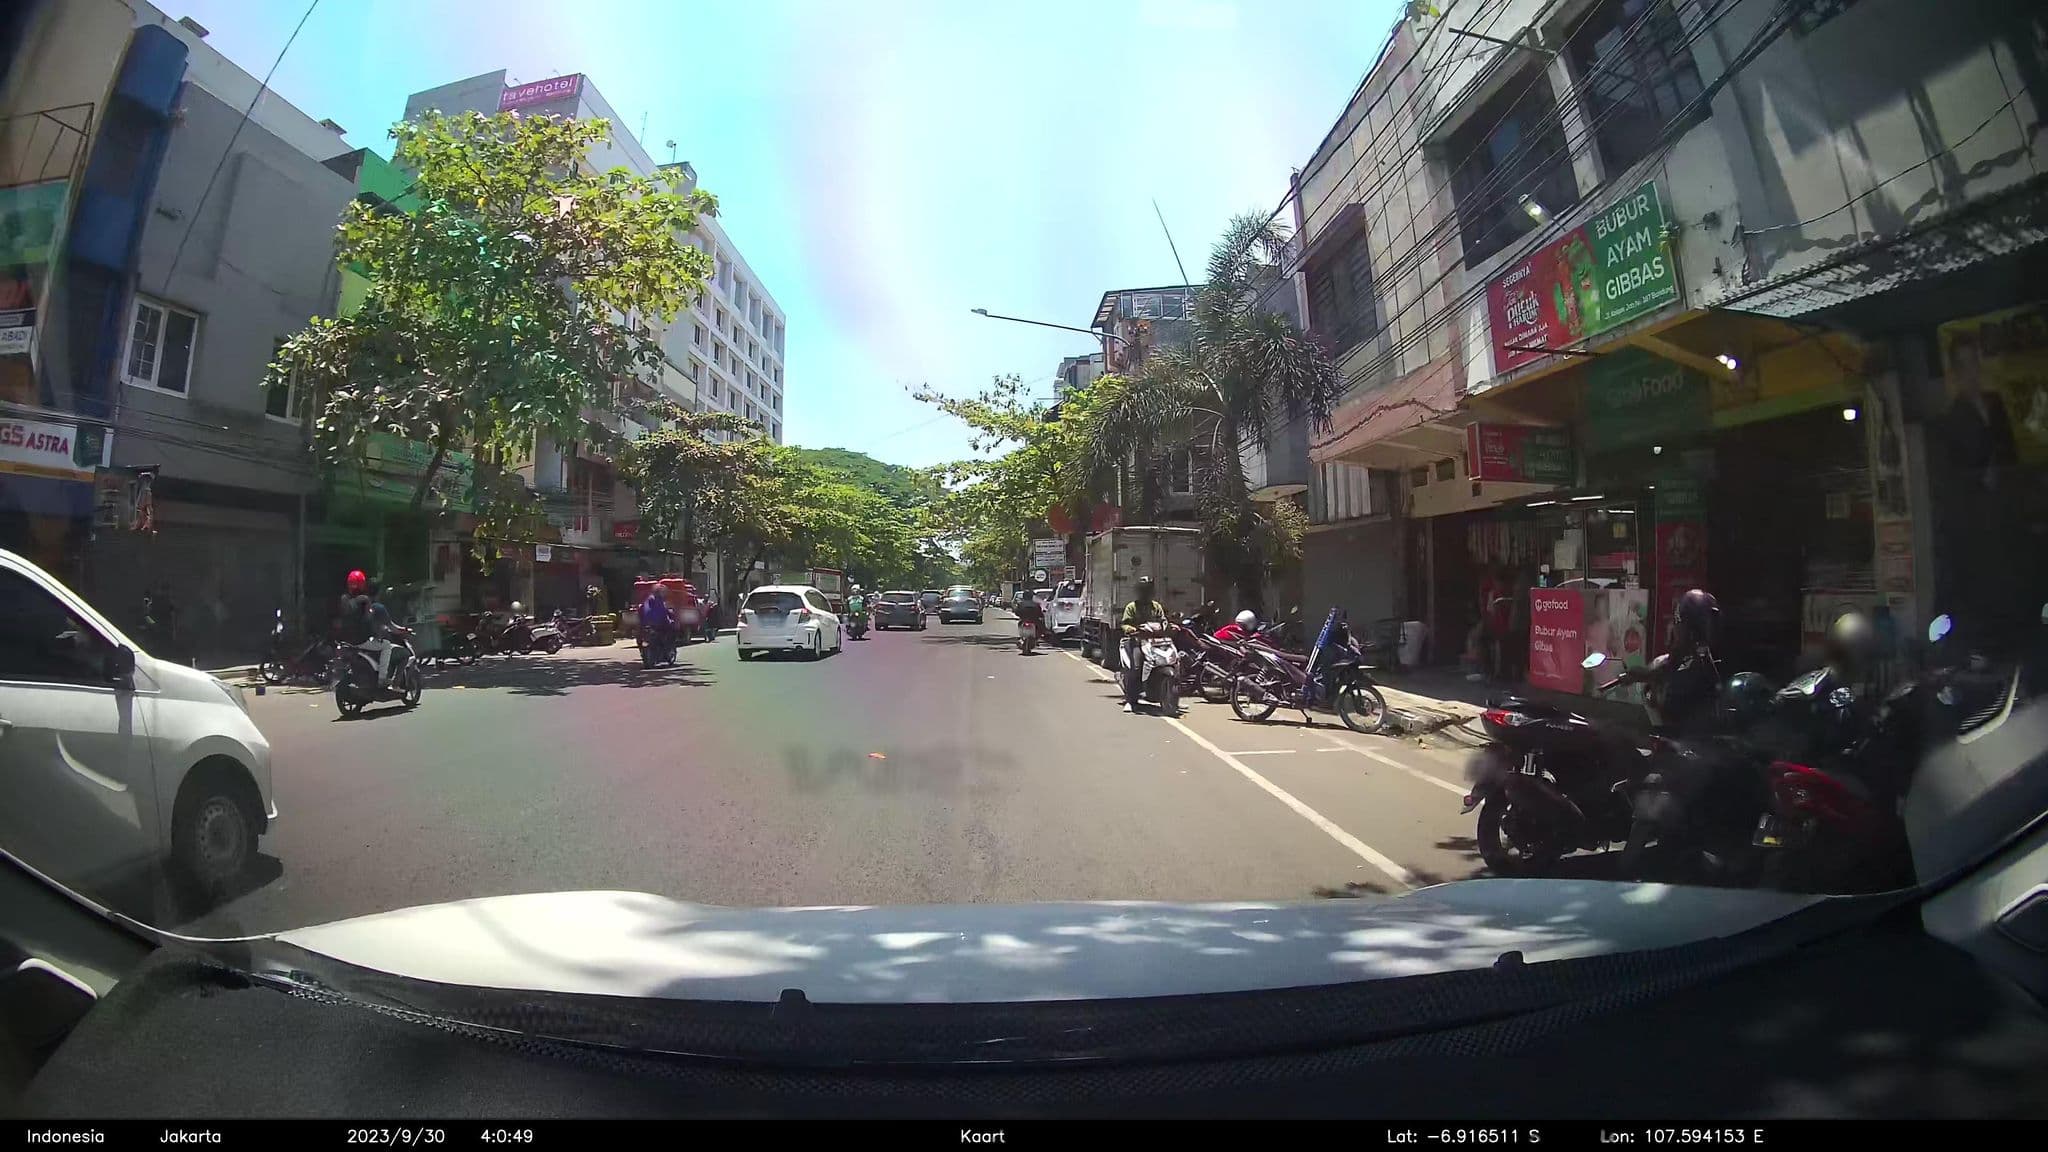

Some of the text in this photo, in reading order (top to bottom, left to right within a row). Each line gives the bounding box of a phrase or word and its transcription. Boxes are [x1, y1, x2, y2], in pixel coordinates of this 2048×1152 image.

[1596, 194, 1650, 240] BUBUR
[1607, 226, 1652, 267] AYAM
[1606, 256, 1665, 300] GIBBAS
[26, 431, 69, 455] ASTRA
[1543, 599, 1569, 611] gofood
